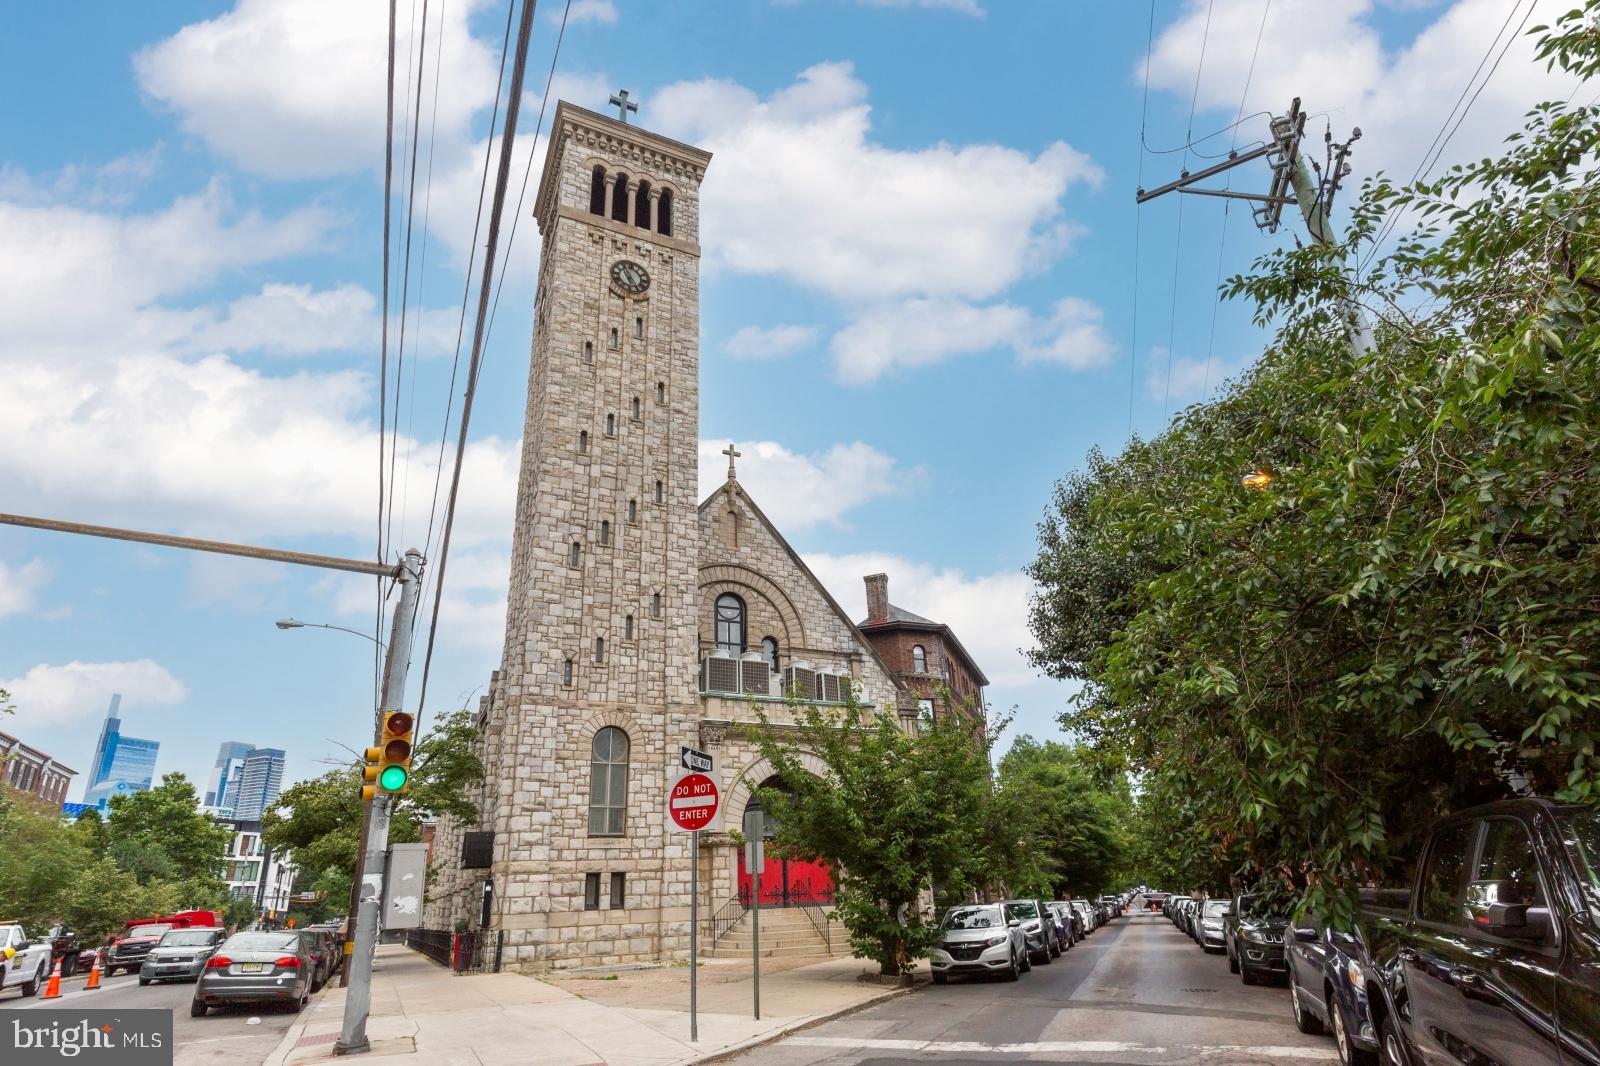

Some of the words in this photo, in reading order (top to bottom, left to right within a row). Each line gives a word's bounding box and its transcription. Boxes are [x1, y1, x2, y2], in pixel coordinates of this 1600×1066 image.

[690, 755, 700, 767] ONE
[700, 759, 710, 769] WAY
[676, 786, 689, 796] DO
[694, 783, 711, 794] NOT
[679, 809, 708, 820] ENTER
